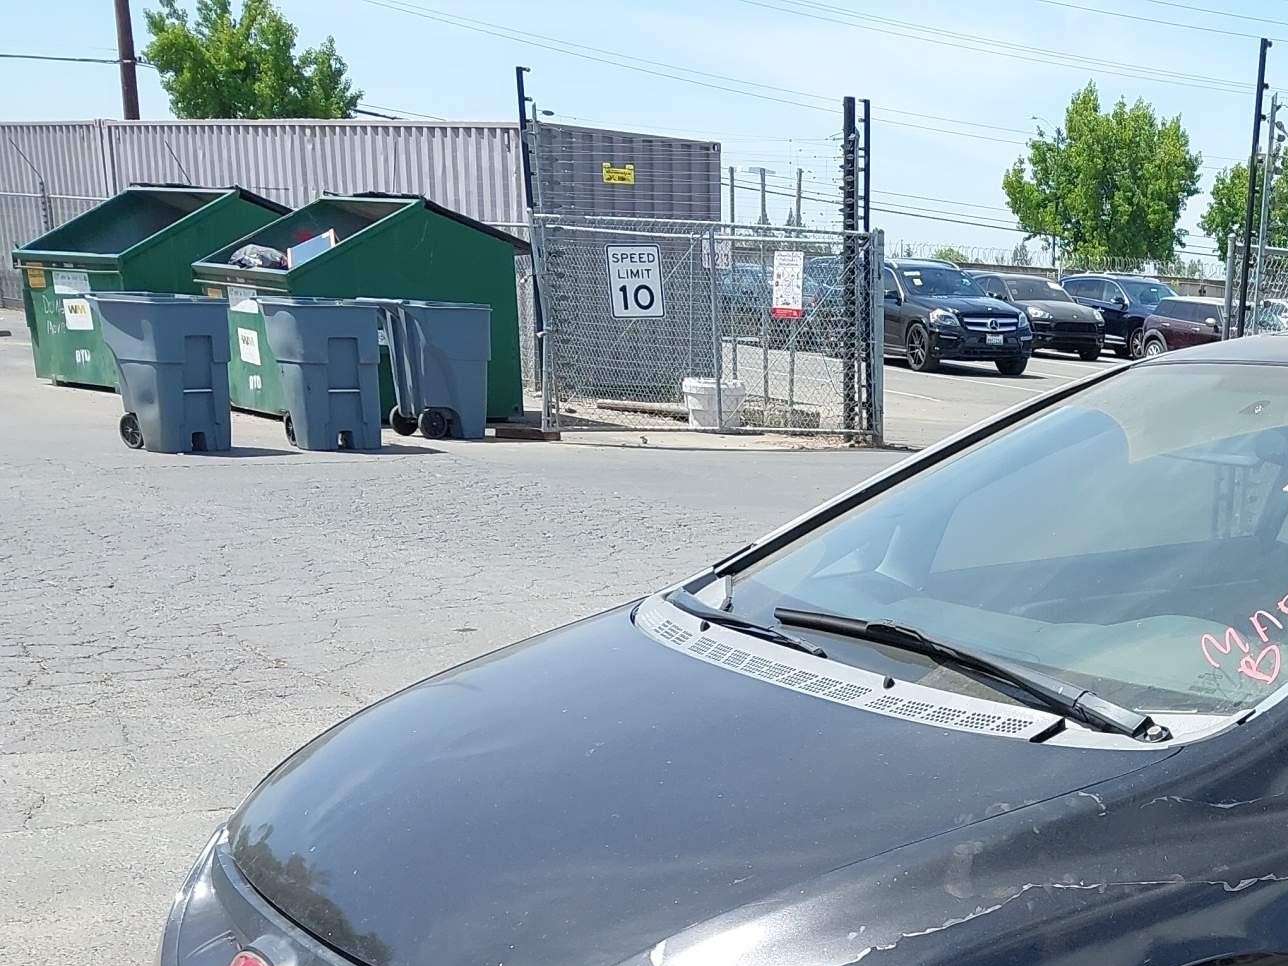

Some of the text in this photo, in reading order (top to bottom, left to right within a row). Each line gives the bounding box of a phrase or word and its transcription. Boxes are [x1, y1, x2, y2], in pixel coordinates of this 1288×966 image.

[612, 252, 655, 263] SPEED
[617, 268, 652, 279] LIMIT
[619, 284, 655, 310] 10
